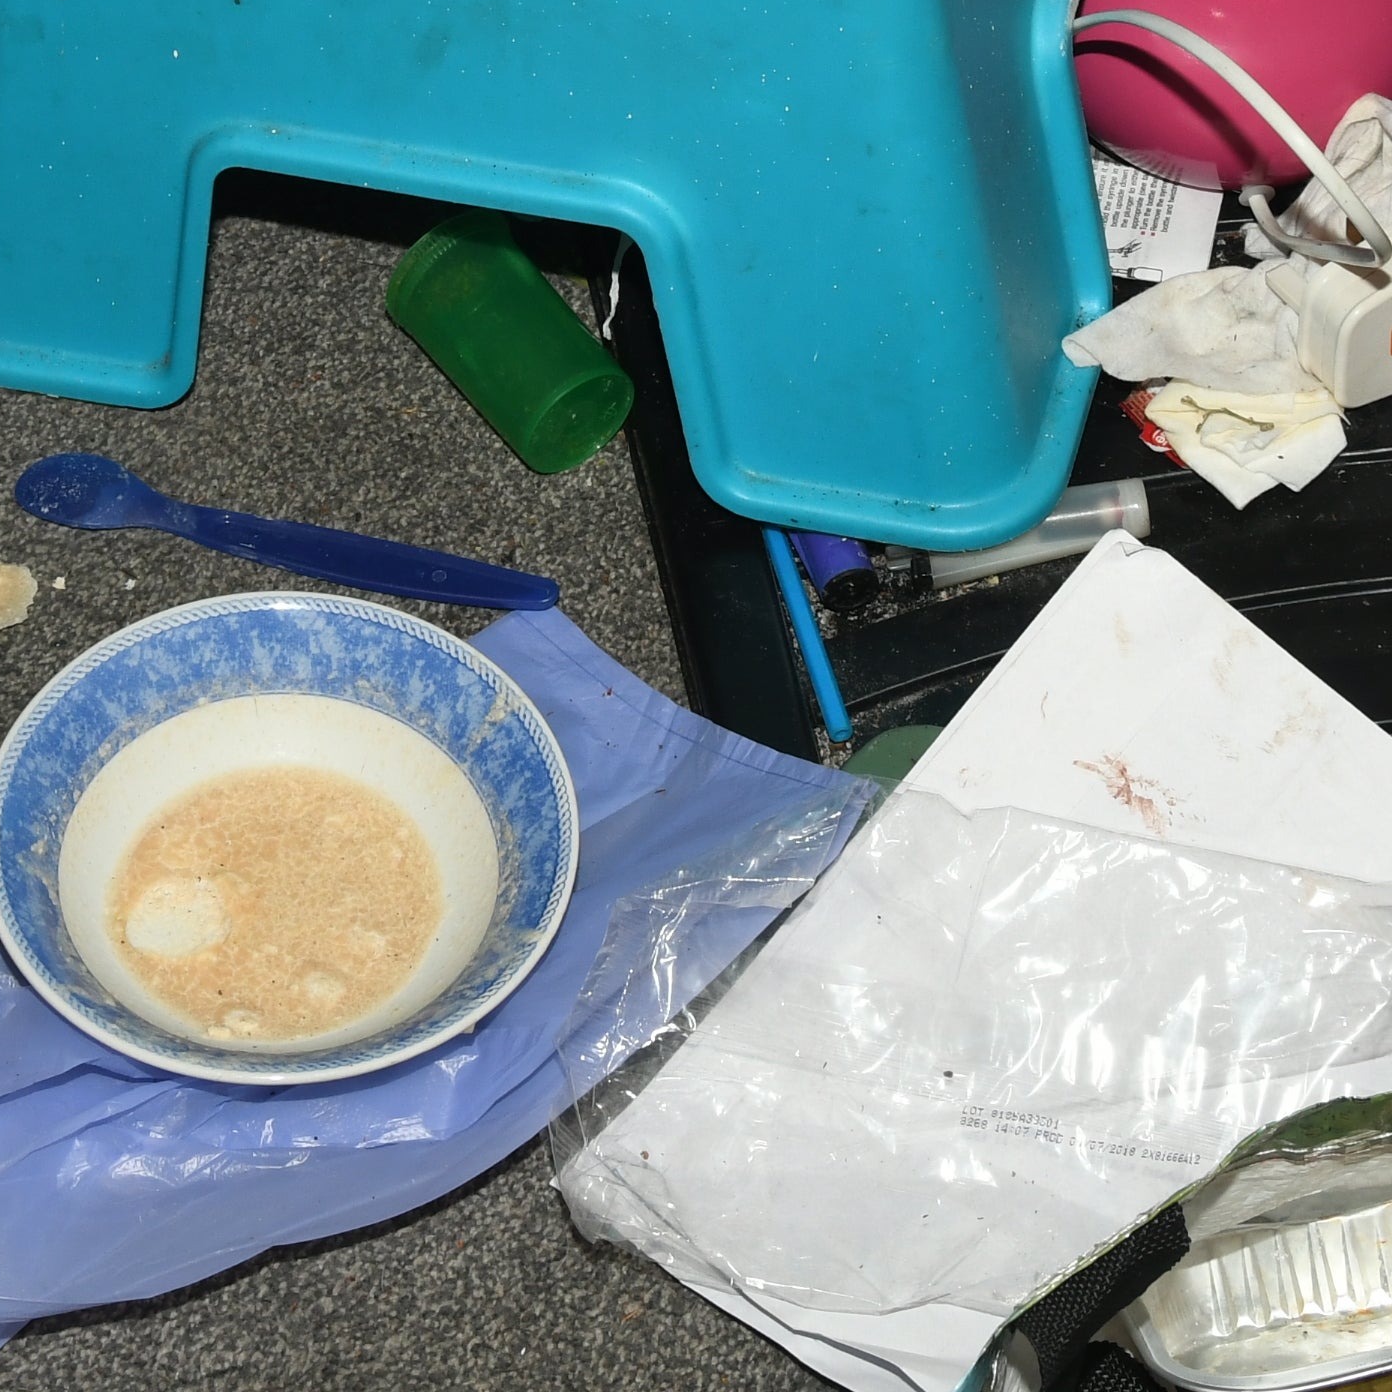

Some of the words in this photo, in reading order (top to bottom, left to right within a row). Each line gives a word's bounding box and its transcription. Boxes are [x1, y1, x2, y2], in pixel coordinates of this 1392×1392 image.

[1108, 176, 1118, 199] syringe
[1119, 169, 1128, 187] down
[1116, 189, 1125, 209] upside
[1146, 190, 1156, 207] bottle
[1110, 211, 1120, 227] bottle
[1120, 219, 1128, 228] the
[1124, 195, 1134, 218] plunger
[1131, 197, 1144, 229] appropriate
[1144, 208, 1152, 217] the
[1150, 208, 1161, 231] Remove
[1156, 198, 1164, 208] the
[1161, 216, 1170, 233] bottle
[1166, 204, 1174, 215] and
[1139, 218, 1148, 230] Turn
[962, 1106, 984, 1115] LOT
[1069, 1136, 1136, 1157] 0/07/2018
